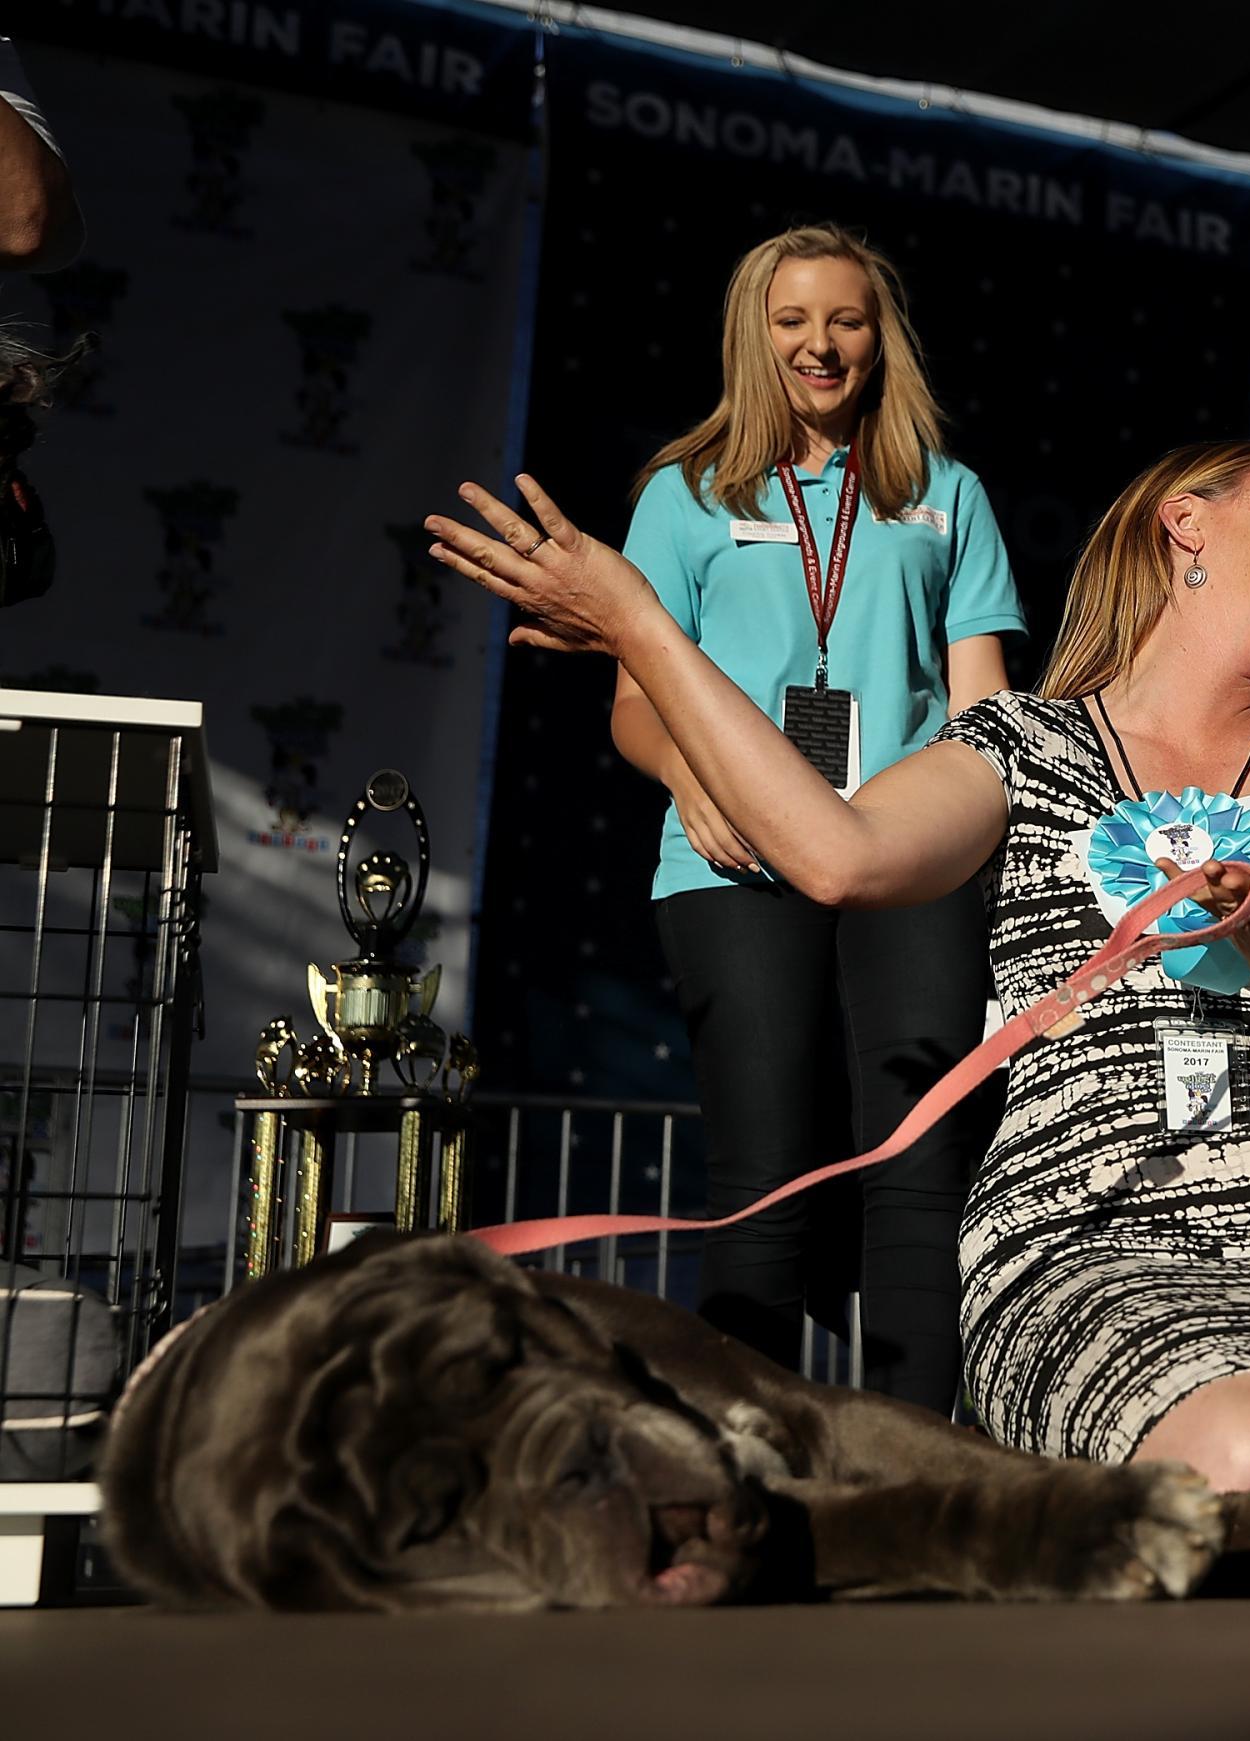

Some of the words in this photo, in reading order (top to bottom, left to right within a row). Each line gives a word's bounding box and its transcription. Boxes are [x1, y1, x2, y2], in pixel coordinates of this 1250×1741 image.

[60, 0, 299, 55] ARIN
[328, 18, 485, 97] FAIR
[584, 78, 1085, 227] SONOMA-MARIN
[1103, 190, 1232, 257] FAIR
[842, 495, 852, 514] Event
[808, 565, 818, 591] Event
[1168, 1040, 1223, 1048] CONTESTANT
[1183, 1057, 1209, 1066] 2017
